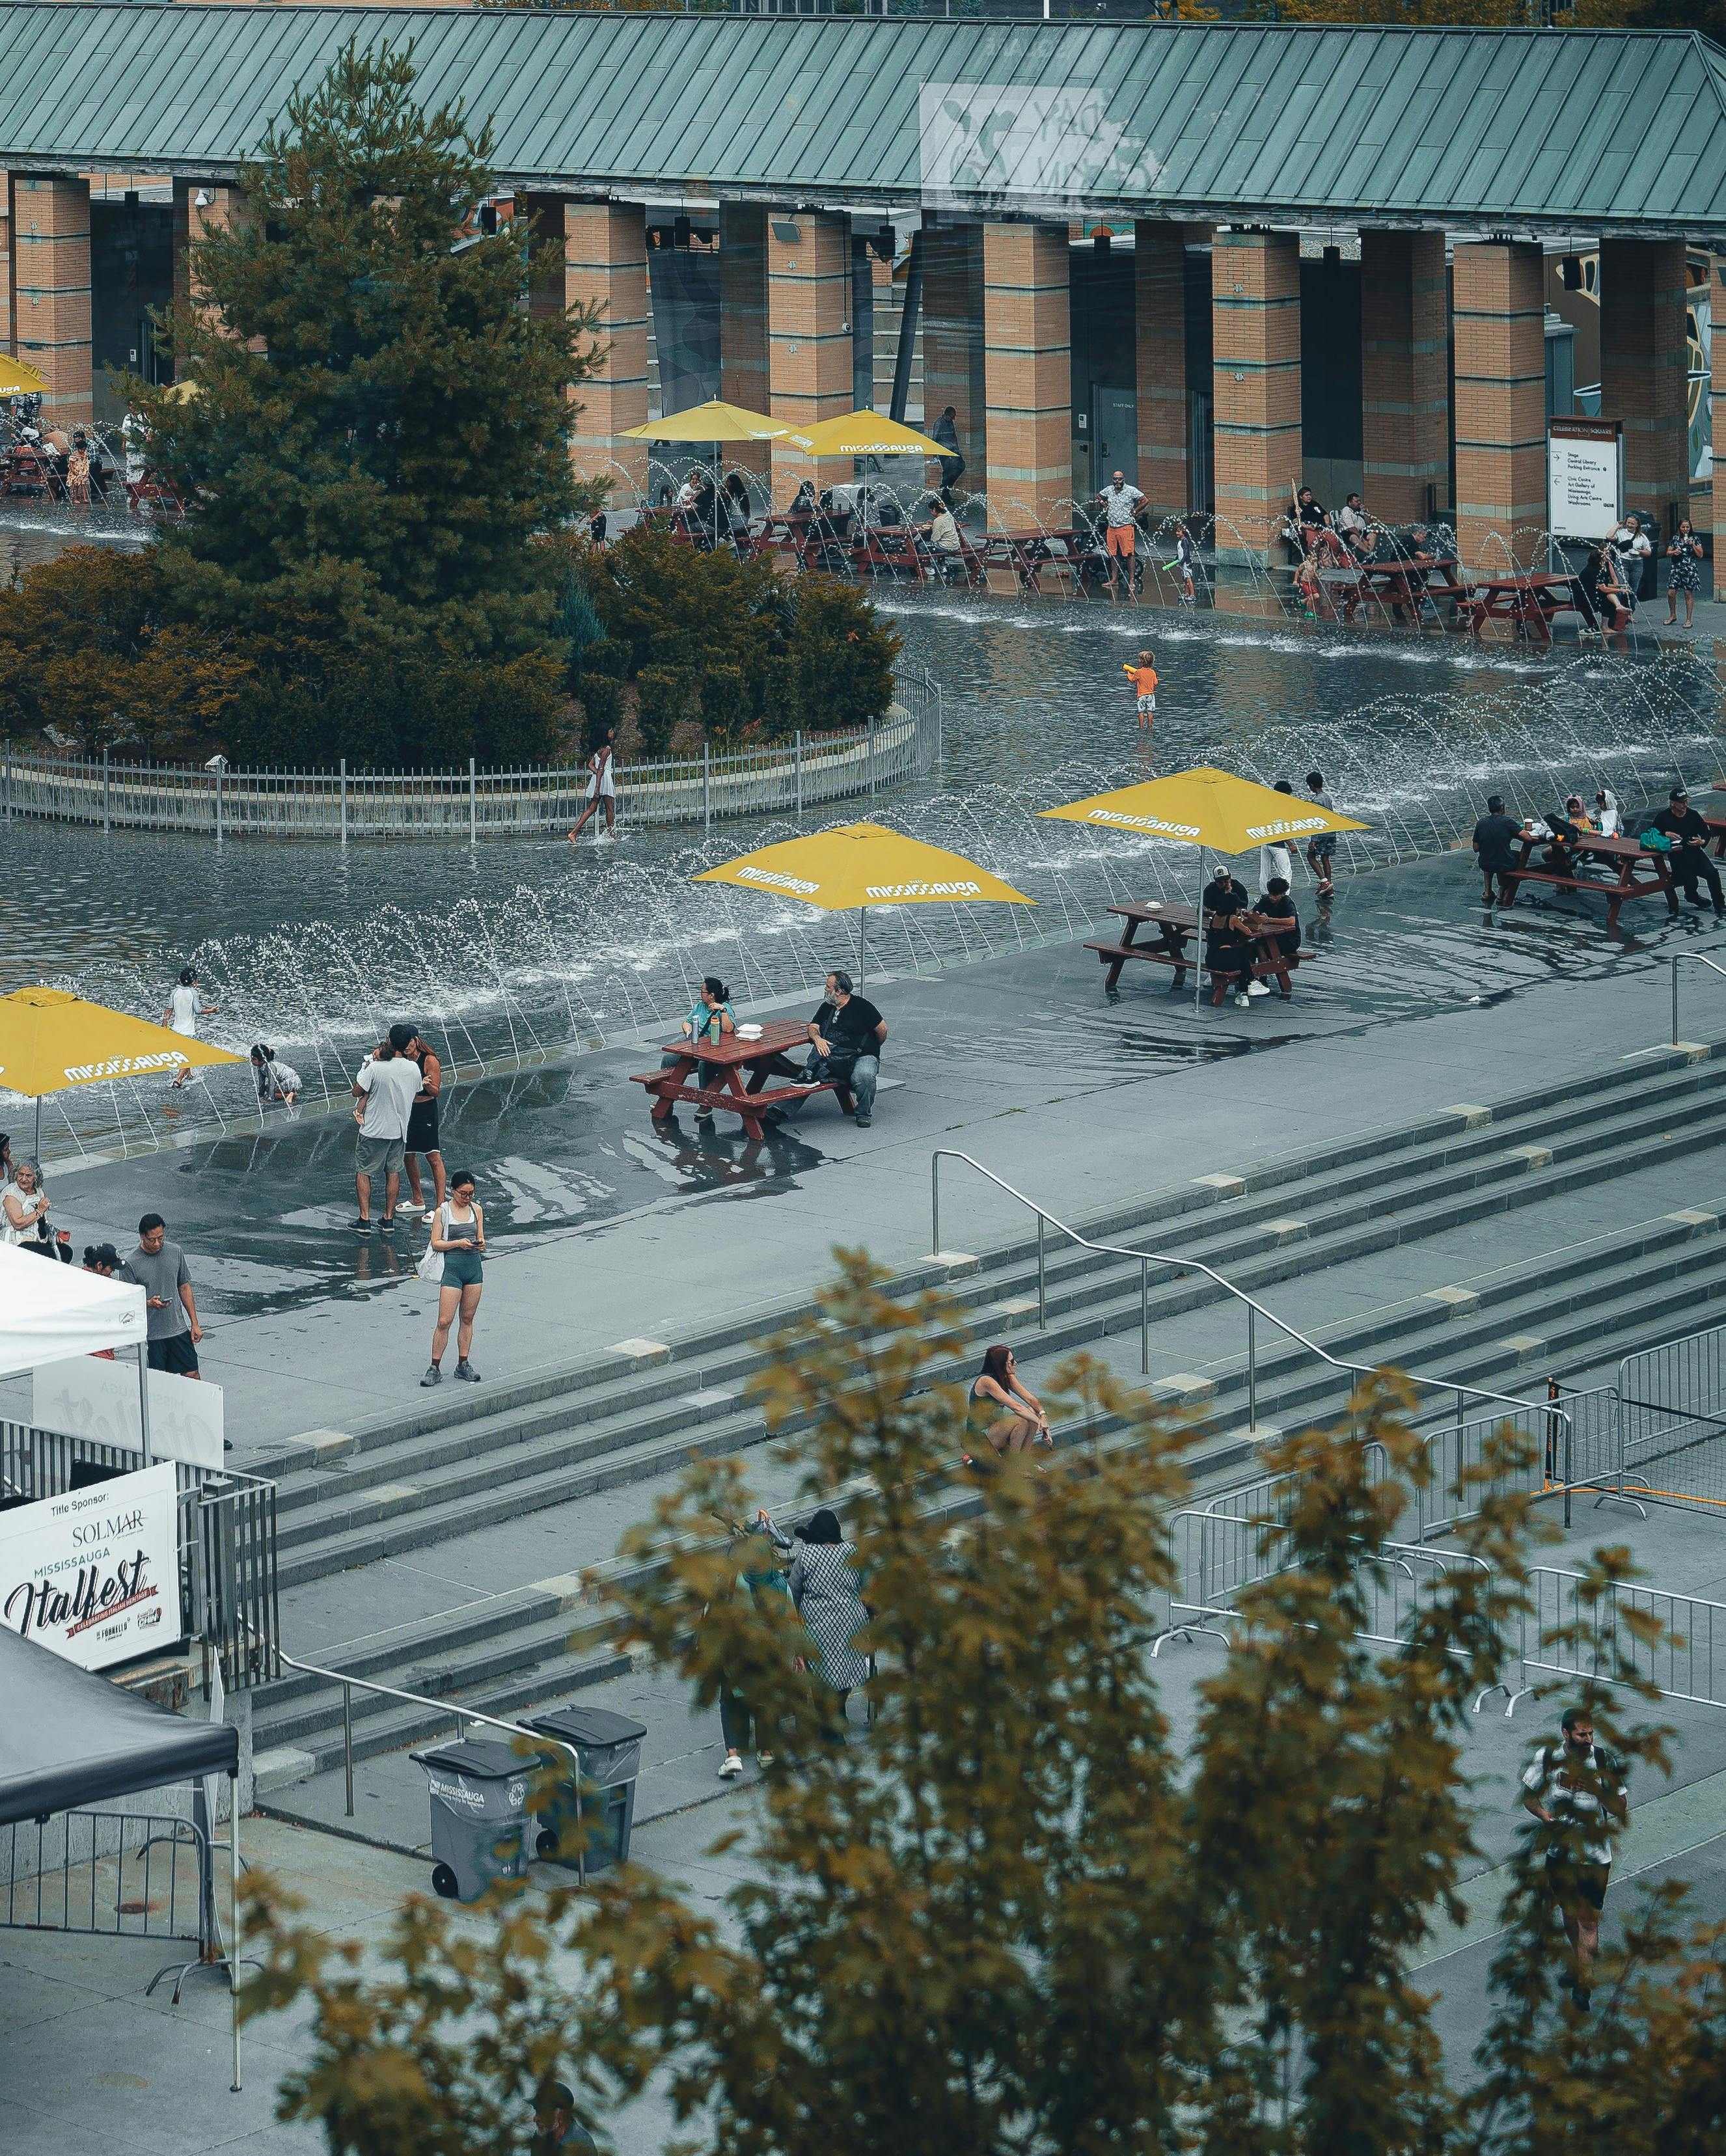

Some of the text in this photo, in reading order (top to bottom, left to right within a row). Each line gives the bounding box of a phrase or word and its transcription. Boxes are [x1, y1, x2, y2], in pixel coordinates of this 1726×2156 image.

[840, 445, 924, 454] MISSISSAUGA
[1087, 809, 1200, 837] MISSISSAUGA
[1246, 817, 1330, 839] MISSISSAUGA
[735, 866, 820, 894] MISSISSAUGA
[866, 881, 981, 898] MISSISSAUGA
[64, 1051, 190, 1082] MISSISSAUGA
[51, 1493, 109, 1517] Title Sponsor:
[72, 1509, 144, 1548] SOLMAR
[34, 1547, 111, 1579] MISSISSAUGA
[5, 1549, 151, 1638] Italfest
[441, 1783, 485, 1804] MISSISSAUGA
